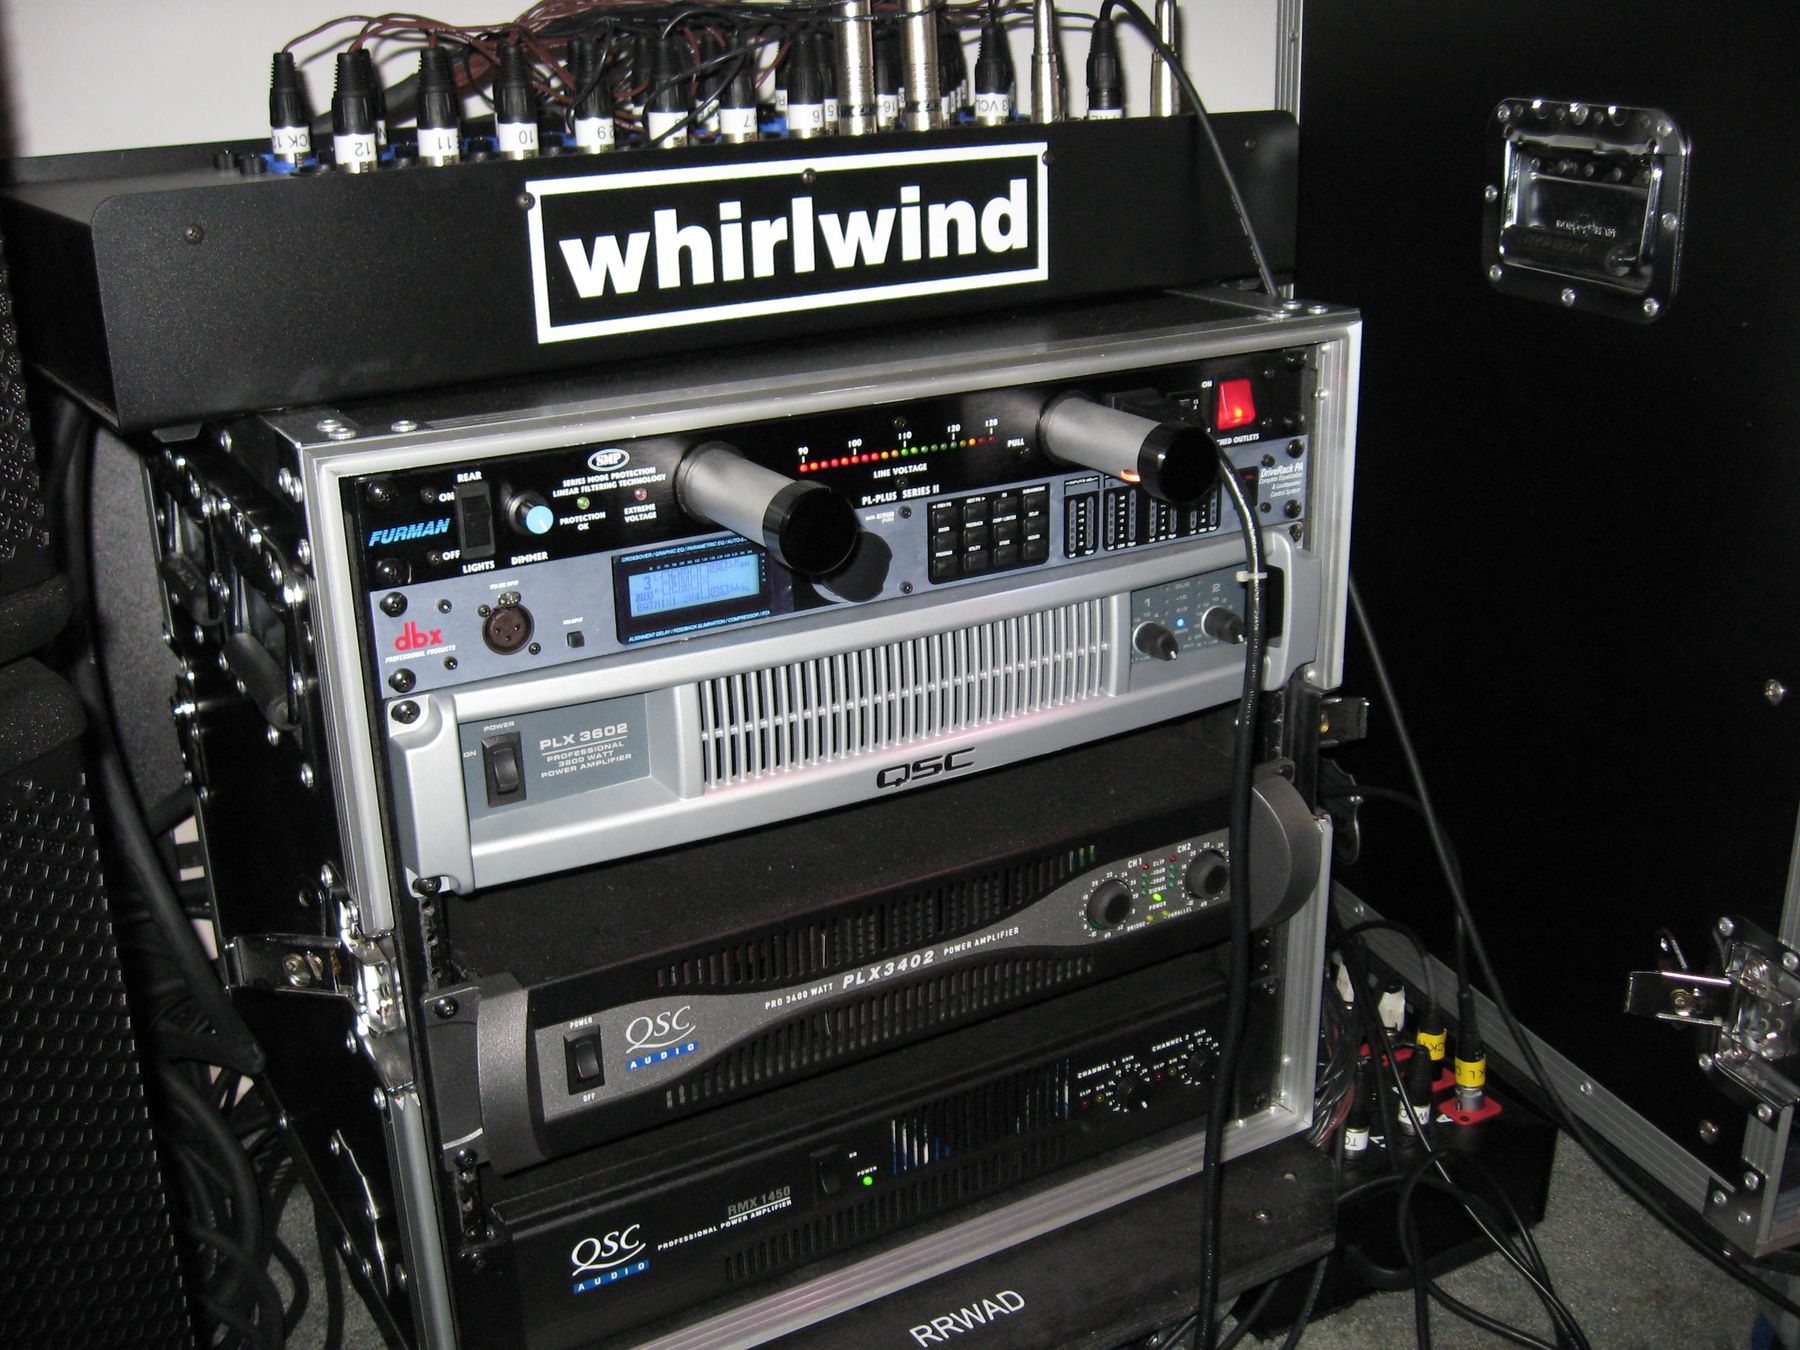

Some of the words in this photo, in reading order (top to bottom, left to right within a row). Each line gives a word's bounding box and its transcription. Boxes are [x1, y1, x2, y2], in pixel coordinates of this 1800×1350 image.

[518, 130, 534, 144] 10
[354, 142, 371, 157] 12
[559, 178, 1028, 298] whirlwind
[1202, 380, 1213, 388] ON
[898, 431, 912, 440] 110
[947, 424, 961, 433] 120
[848, 438, 862, 448] 100
[1007, 438, 1025, 448] PULL
[1233, 433, 1260, 444] OUTLETS
[798, 447, 808, 456] 90
[596, 452, 622, 467] SMP
[457, 471, 482, 483] REAR
[563, 477, 586, 488] SERIES
[587, 474, 609, 484] MODE
[611, 467, 656, 480] PROTECTION
[873, 468, 891, 479] LINE
[893, 463, 928, 476] VOLTAGE
[552, 487, 579, 498] LINEAR
[581, 482, 617, 494] FILTERING
[619, 474, 667, 487] TECHNOLOGY
[439, 492, 455, 502] ON
[862, 491, 897, 506] PL-PLUS
[902, 485, 931, 499] SERIES
[624, 503, 656, 515] EXTREME
[559, 512, 606, 525] PROTECTION
[624, 512, 657, 523] VOLTAGE
[368, 518, 451, 547] FURMAN
[577, 522, 589, 531] OK
[442, 550, 460, 560] OFF
[511, 551, 549, 565] DIMMER
[462, 560, 495, 574] LIGHTS
[394, 621, 443, 650] dbx
[483, 721, 515, 732] POWER
[539, 733, 575, 750] PLX
[579, 723, 628, 741] 3602
[463, 750, 477, 758] ON
[546, 741, 625, 762] PROFESSIONAL
[558, 756, 585, 767] 3600
[586, 751, 614, 762] WATT
[541, 766, 577, 778] POWER
[580, 754, 632, 770] AMPLIFIER
[877, 747, 975, 788] QSC
[943, 941, 972, 956] POWER
[974, 927, 1019, 946] AMPLIFIER
[842, 950, 935, 989] PLX3402
[765, 998, 783, 1010] PRO
[810, 982, 833, 996] WATT
[569, 1017, 593, 1029] POWER
[625, 1005, 697, 1054] QSC
[1152, 1037, 1183, 1052] CHANNEL
[630, 1043, 695, 1070] AUDIO
[1077, 1063, 1110, 1079] CHANNEL
[583, 1093, 596, 1103] OFF
[857, 1165, 877, 1177] POWER
[728, 1197, 758, 1217] RMX
[760, 1186, 791, 1205] 1450
[657, 1226, 718, 1251] PROFESSIONAL
[720, 1215, 748, 1230] POWER
[750, 1199, 792, 1218] AMPLIFIER
[570, 1223, 647, 1276] QSC
[578, 1261, 646, 1292] AUDIO
[909, 1290, 1026, 1348] RRWAD
